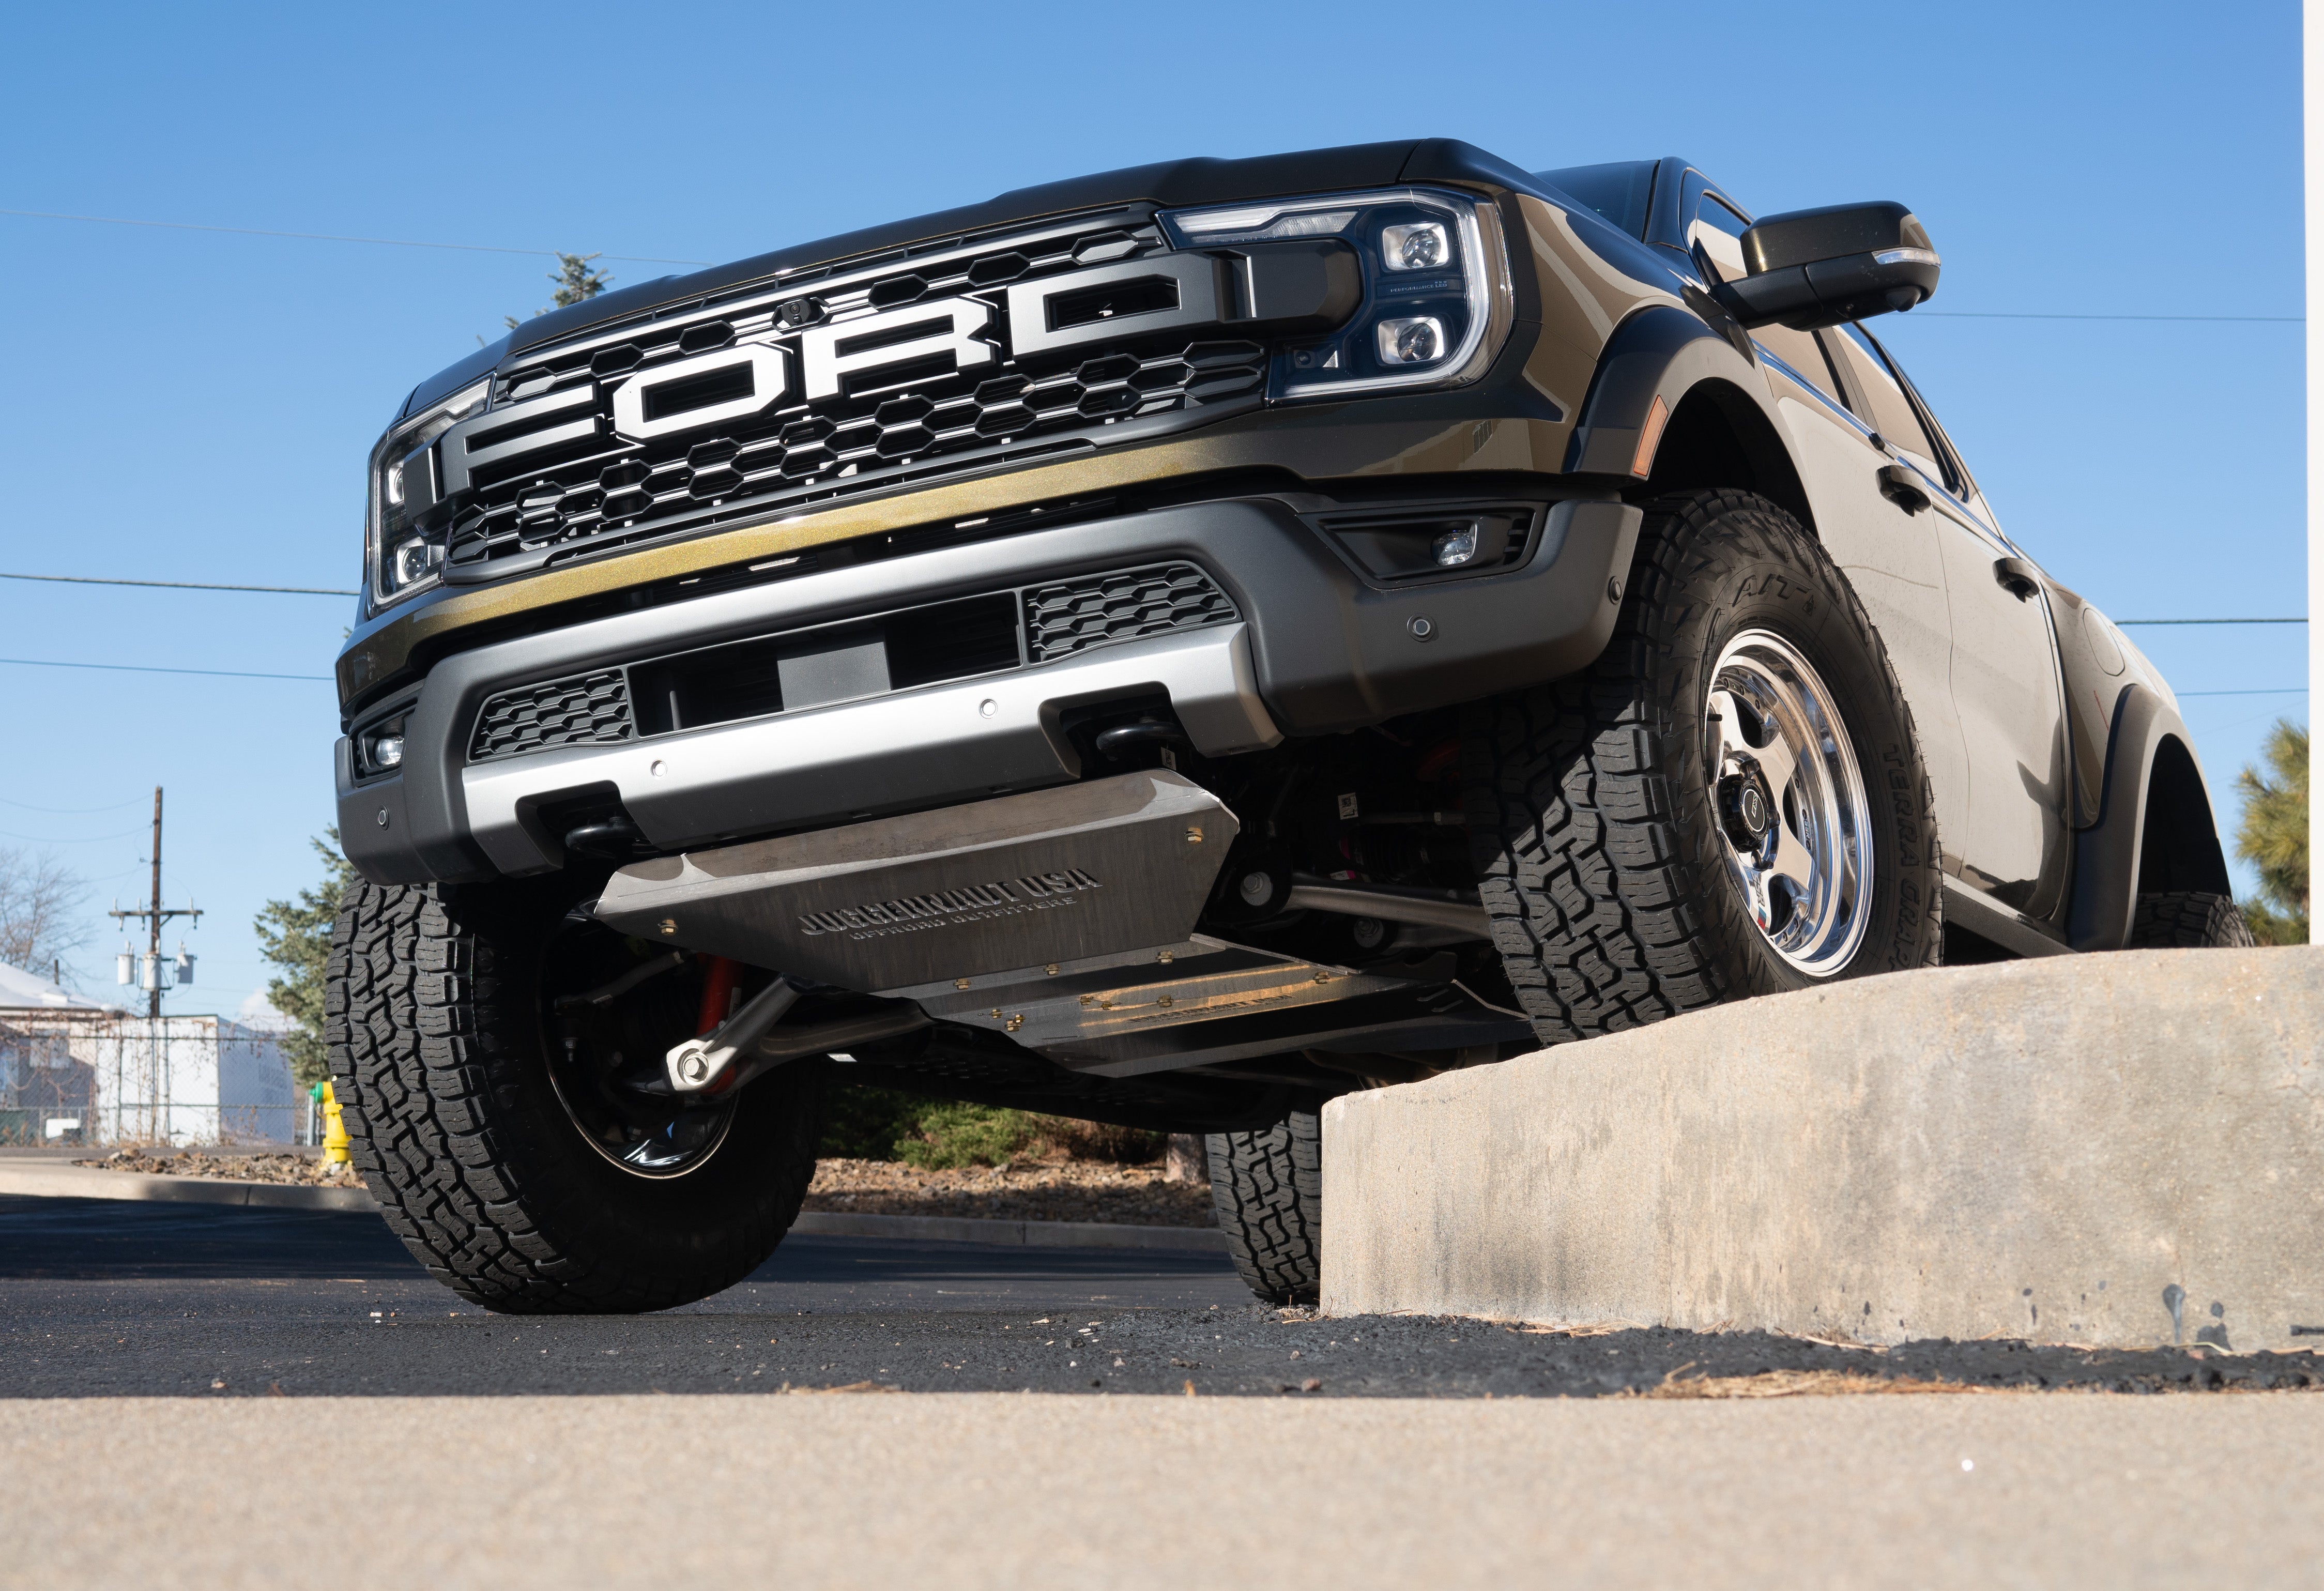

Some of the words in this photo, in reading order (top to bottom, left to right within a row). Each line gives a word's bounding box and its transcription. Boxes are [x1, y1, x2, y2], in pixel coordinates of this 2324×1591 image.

[1390, 284, 1434, 293] PERFORMANCE
[440, 252, 1234, 499] FORD
[1883, 743, 1920, 867] TERRA
[799, 881, 1020, 936] JUGGERNAUT
[1015, 868, 1103, 897] USA
[1750, 870, 1766, 907] SSR
[849, 919, 946, 940] OFFROAD
[951, 896, 1077, 923] OUTFITTERS
